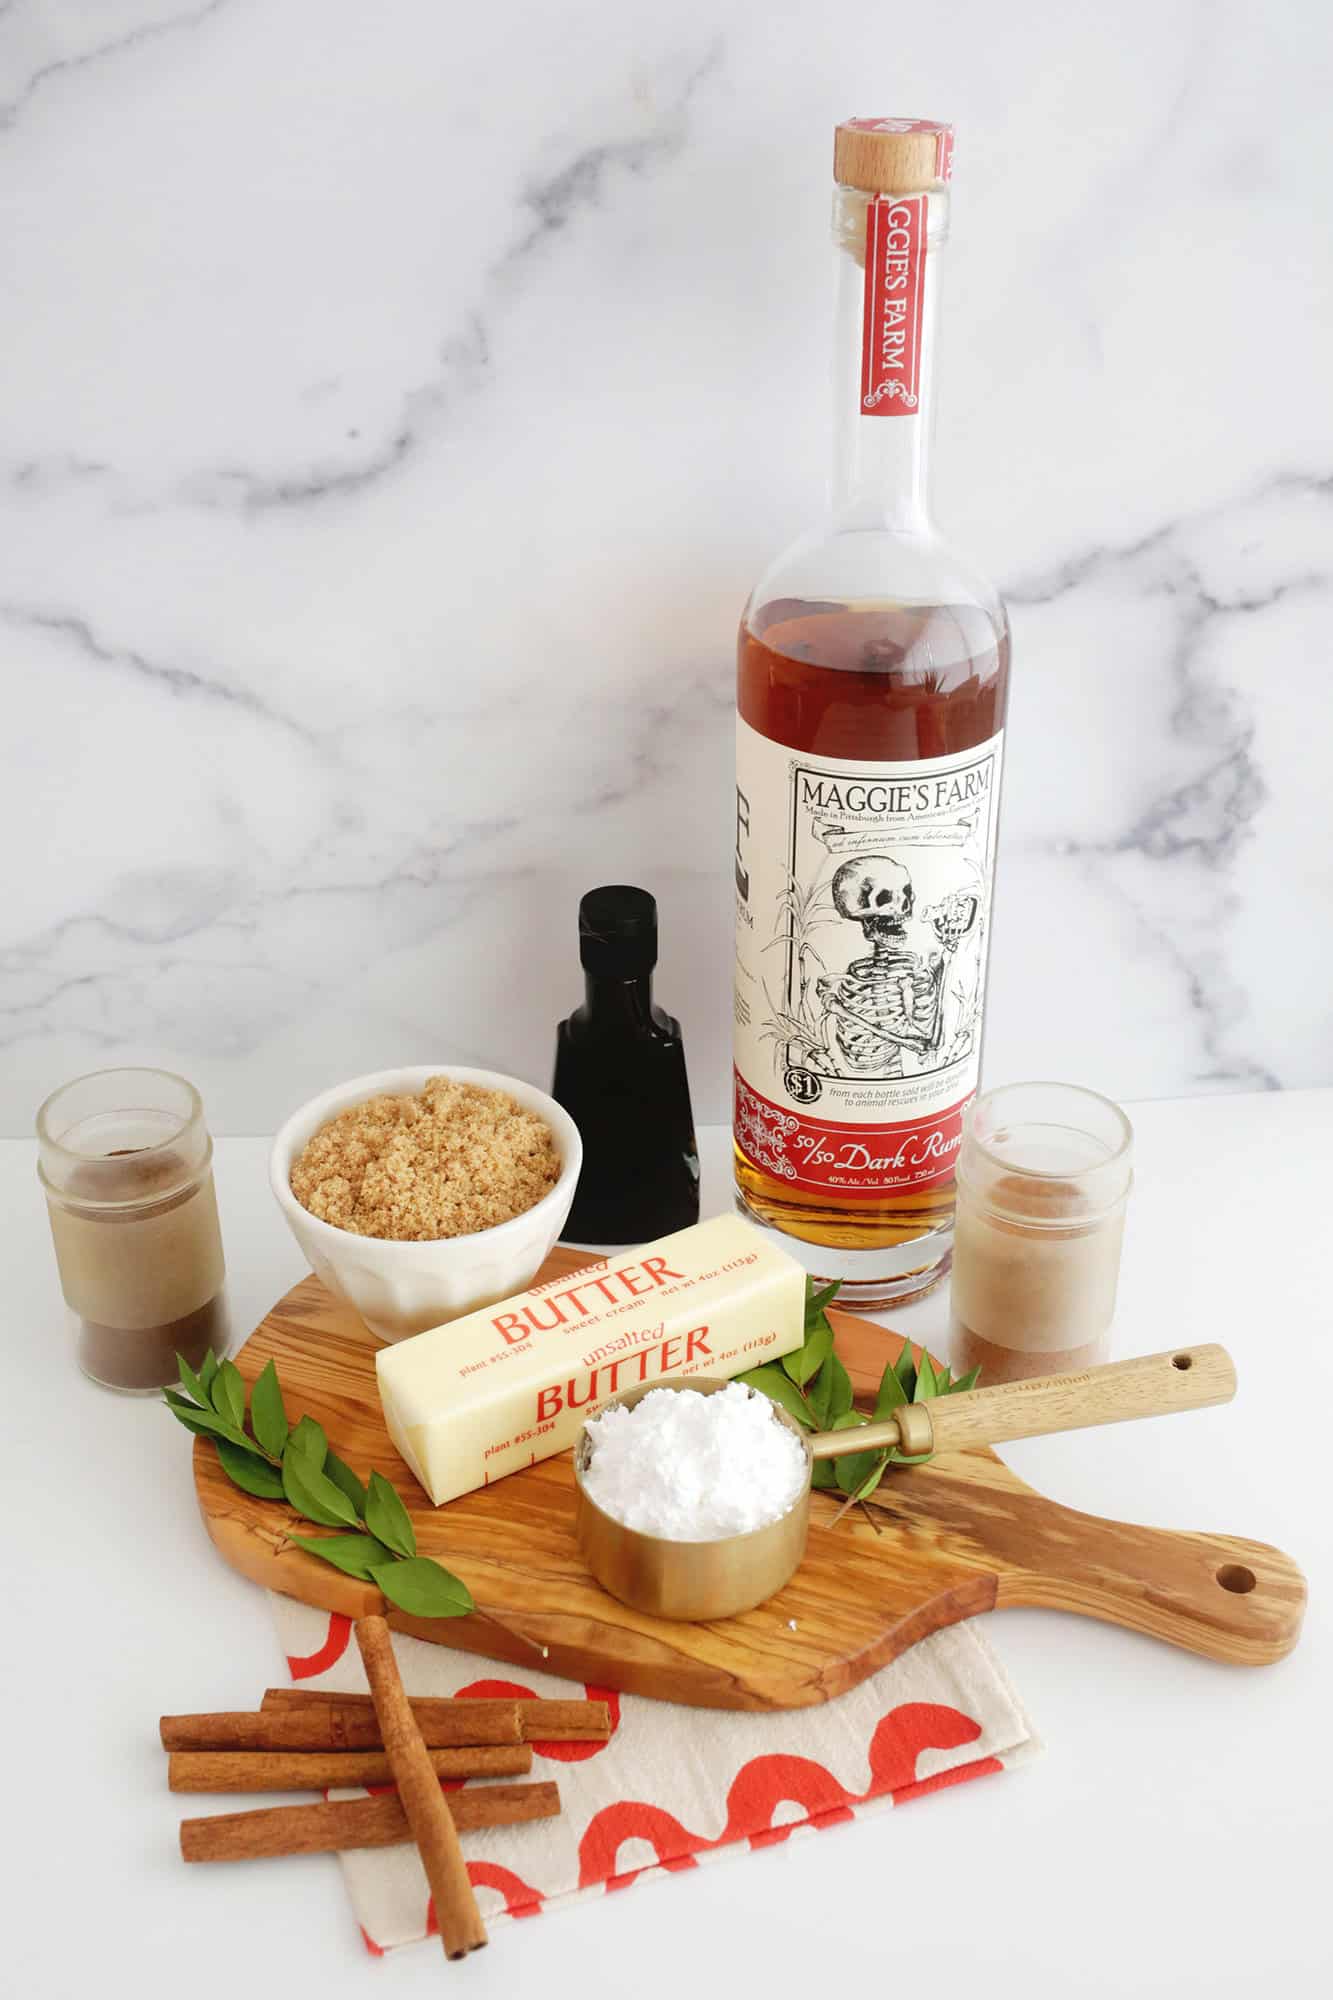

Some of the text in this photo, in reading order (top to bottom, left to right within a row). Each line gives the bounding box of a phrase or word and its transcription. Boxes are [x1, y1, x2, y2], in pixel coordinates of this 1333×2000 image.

[881, 201, 912, 370] GGIE'S FARM
[802, 777, 930, 813] MAGGIE'S
[934, 764, 990, 809] FARM
[790, 1072, 815, 1099] $1
[829, 1087, 850, 1098] from
[852, 1088, 873, 1099] each
[875, 1086, 900, 1099] bottle
[844, 1098, 854, 1107] to
[855, 1096, 886, 1107] animal
[793, 1135, 835, 1165] 50/50
[834, 1135, 918, 1171] Dark
[491, 1257, 687, 1345] BUTTER
[661, 1286, 680, 1297] net
[563, 1299, 647, 1335] sweet cream
[582, 1322, 664, 1367] unsalted
[459, 1360, 488, 1378] plant
[536, 1325, 713, 1423] BUTTER
[682, 1363, 699, 1377] net
[484, 1440, 511, 1460] plant
